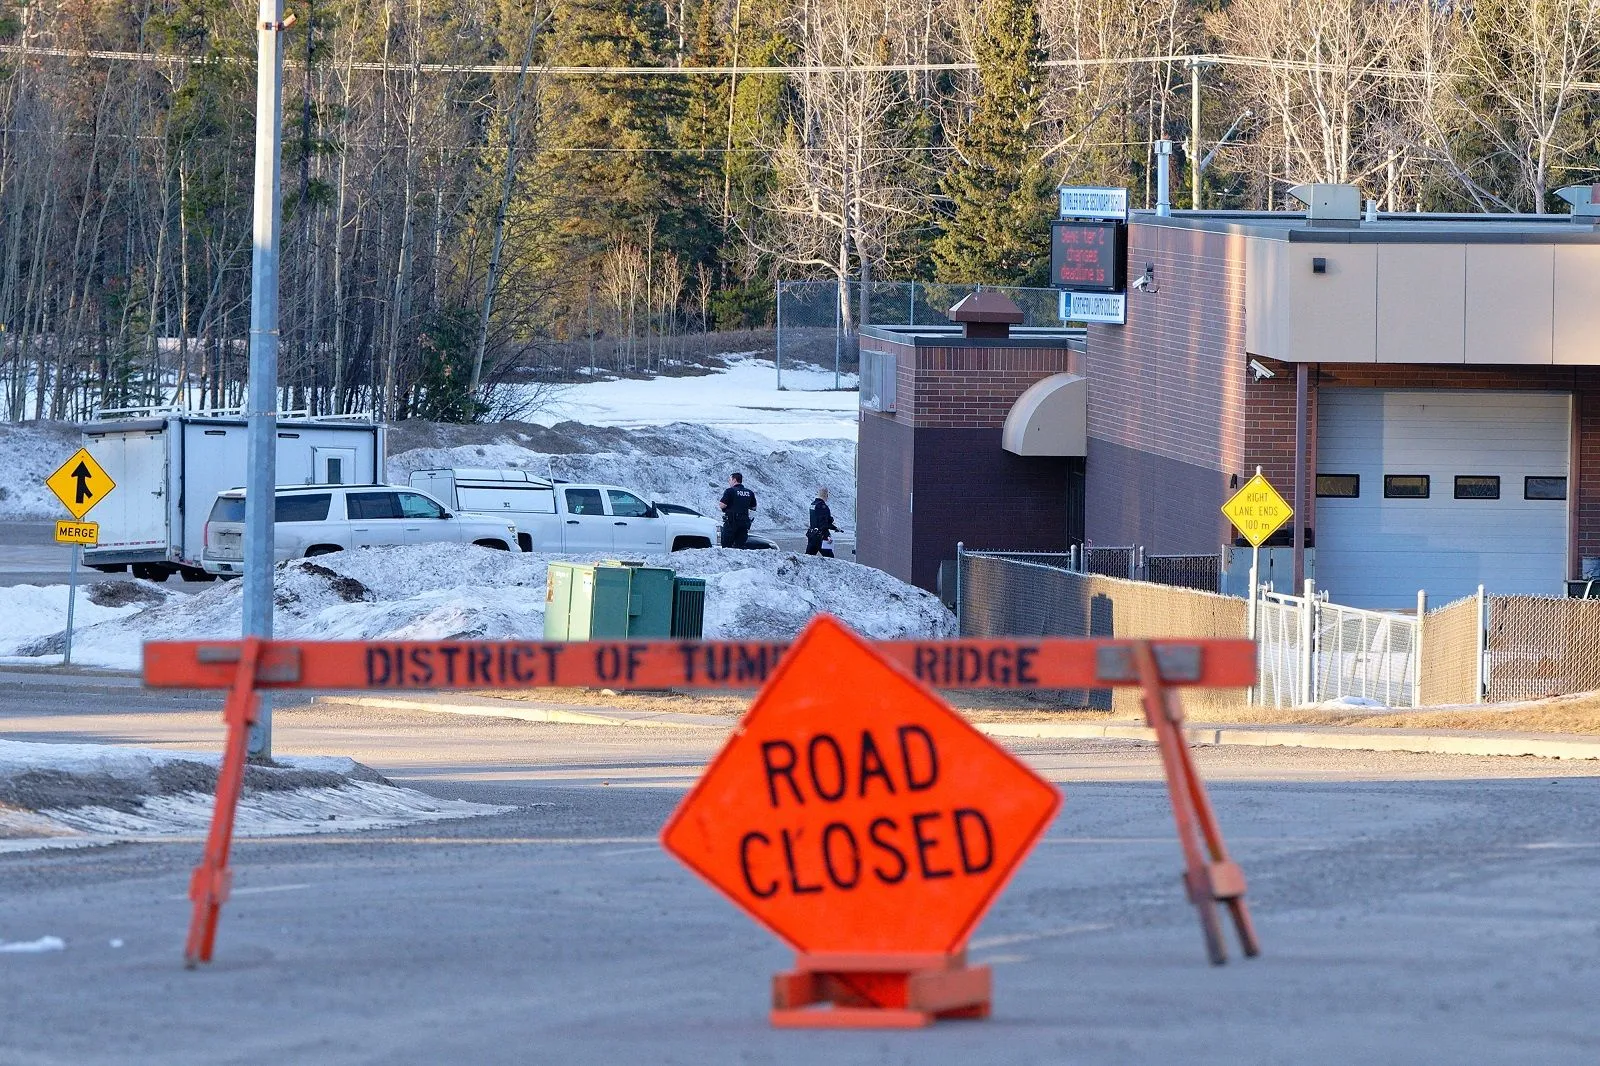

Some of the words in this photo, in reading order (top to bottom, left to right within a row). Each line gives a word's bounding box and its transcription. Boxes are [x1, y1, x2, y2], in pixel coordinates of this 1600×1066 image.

[1247, 493, 1268, 502] RIGHT
[1234, 506, 1253, 516] LANE
[1258, 507, 1278, 516] ENDS
[1245, 520, 1258, 530] 100
[59, 527, 94, 538] MERGE
[365, 646, 567, 687] DISTRICT
[595, 645, 647, 683] OF
[914, 643, 1040, 685] RIDGE
[761, 724, 939, 808] ROAD
[739, 807, 996, 900] CLOSED
